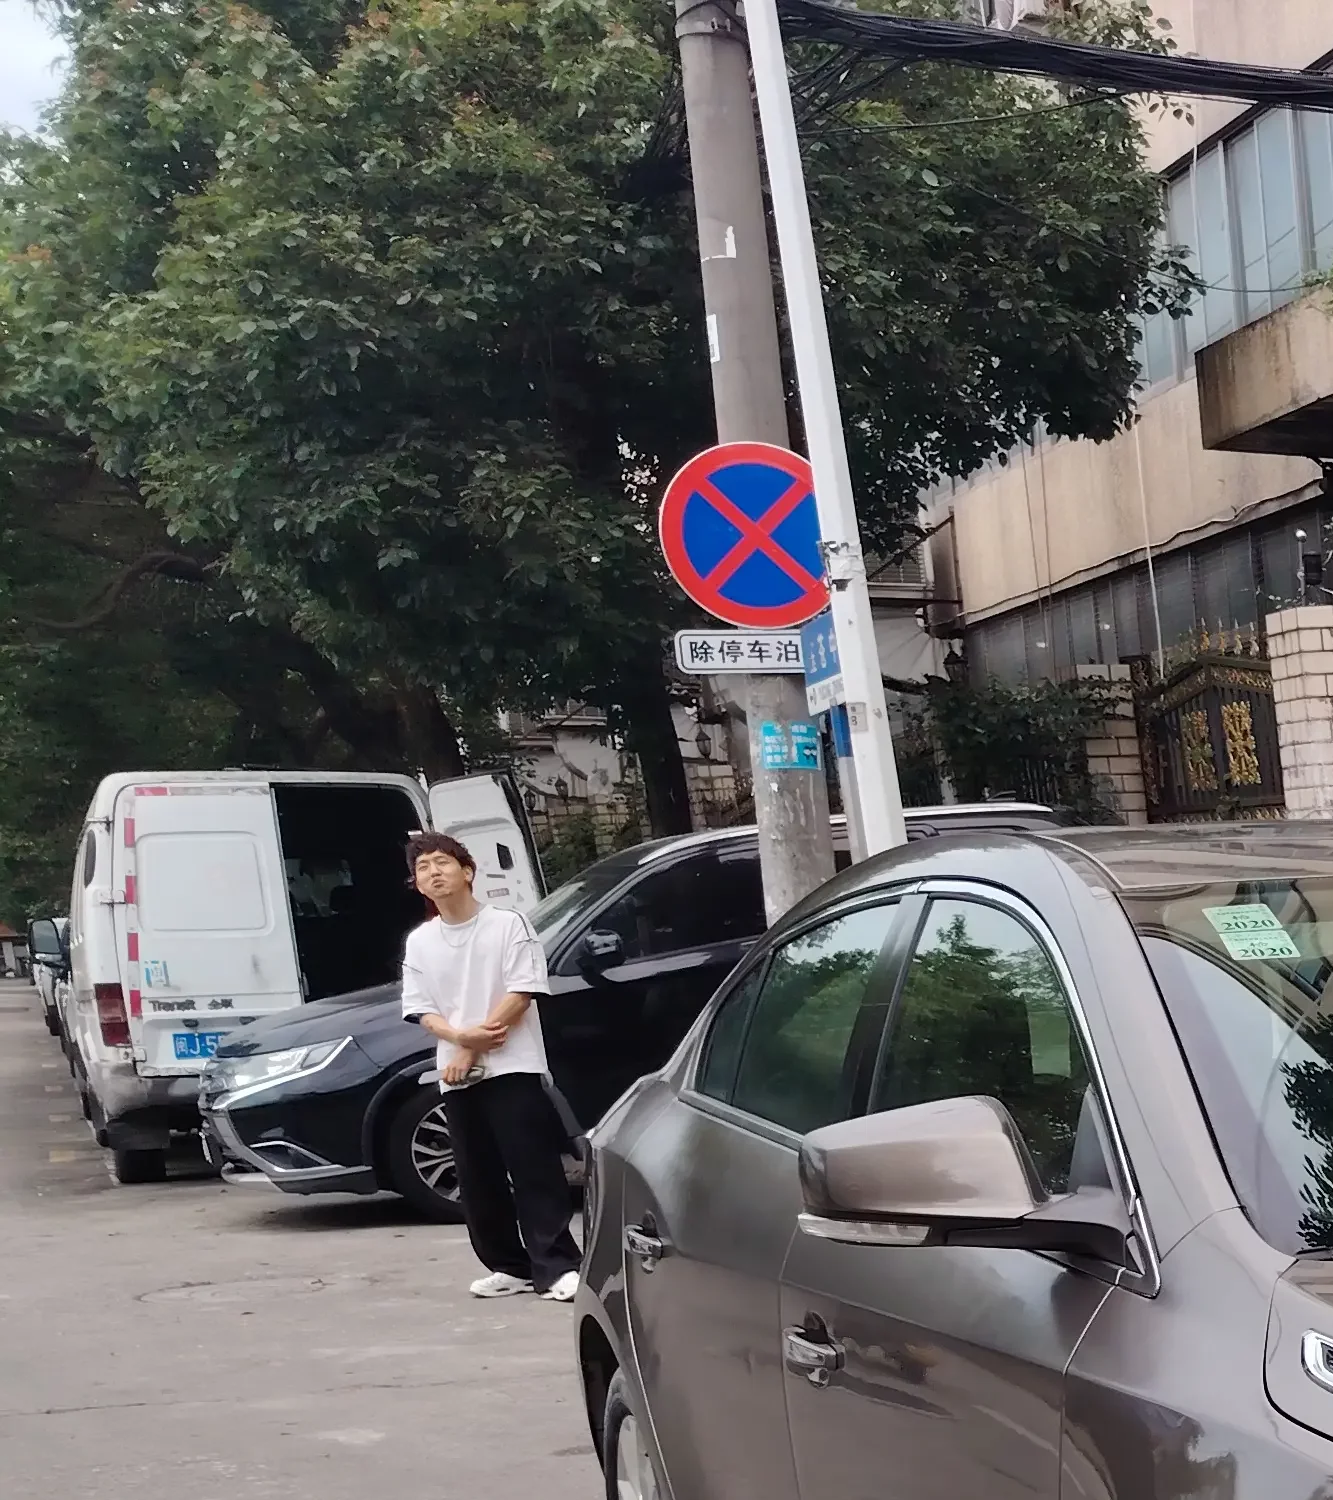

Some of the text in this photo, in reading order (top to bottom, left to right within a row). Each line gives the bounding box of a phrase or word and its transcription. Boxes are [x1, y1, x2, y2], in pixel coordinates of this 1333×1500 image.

[689, 640, 800, 663] 除停车泊
[1221, 919, 1275, 931] 2020
[1238, 946, 1293, 958] 2020
